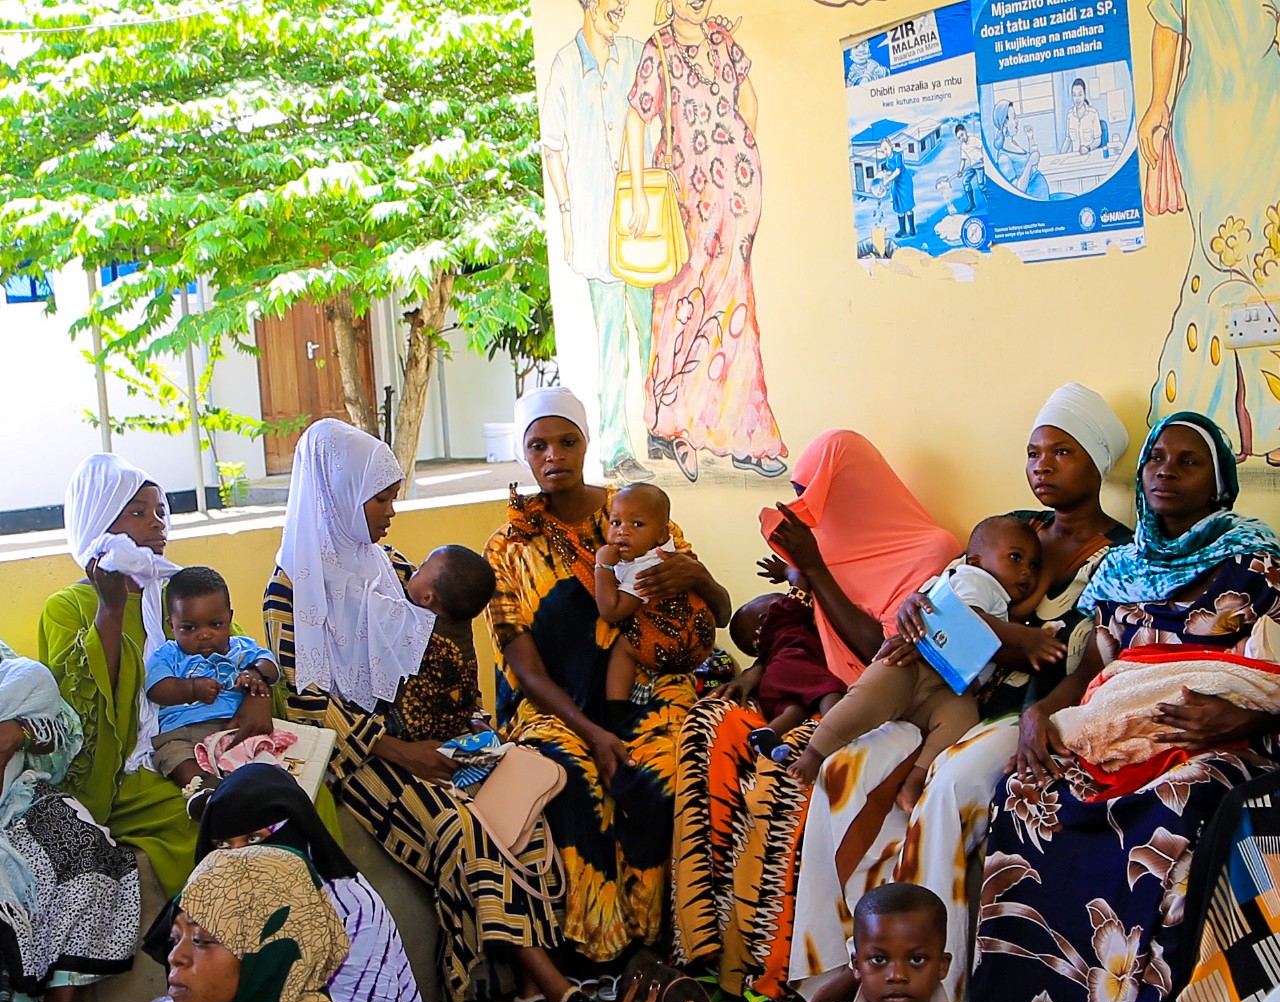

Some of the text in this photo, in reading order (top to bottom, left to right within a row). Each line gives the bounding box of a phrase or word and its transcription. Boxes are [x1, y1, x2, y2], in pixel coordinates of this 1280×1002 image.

[980, 0, 1117, 38] dozi tatu au zaidi za SP,
[991, 0, 1044, 18] Mjamzito
[891, 31, 938, 55] MALARIA
[994, 24, 1104, 53] ili kujikinga na madhara
[998, 39, 1102, 70] yatokanayo na malaria
[870, 76, 962, 98] Dhibiti mazalia ya mbu
